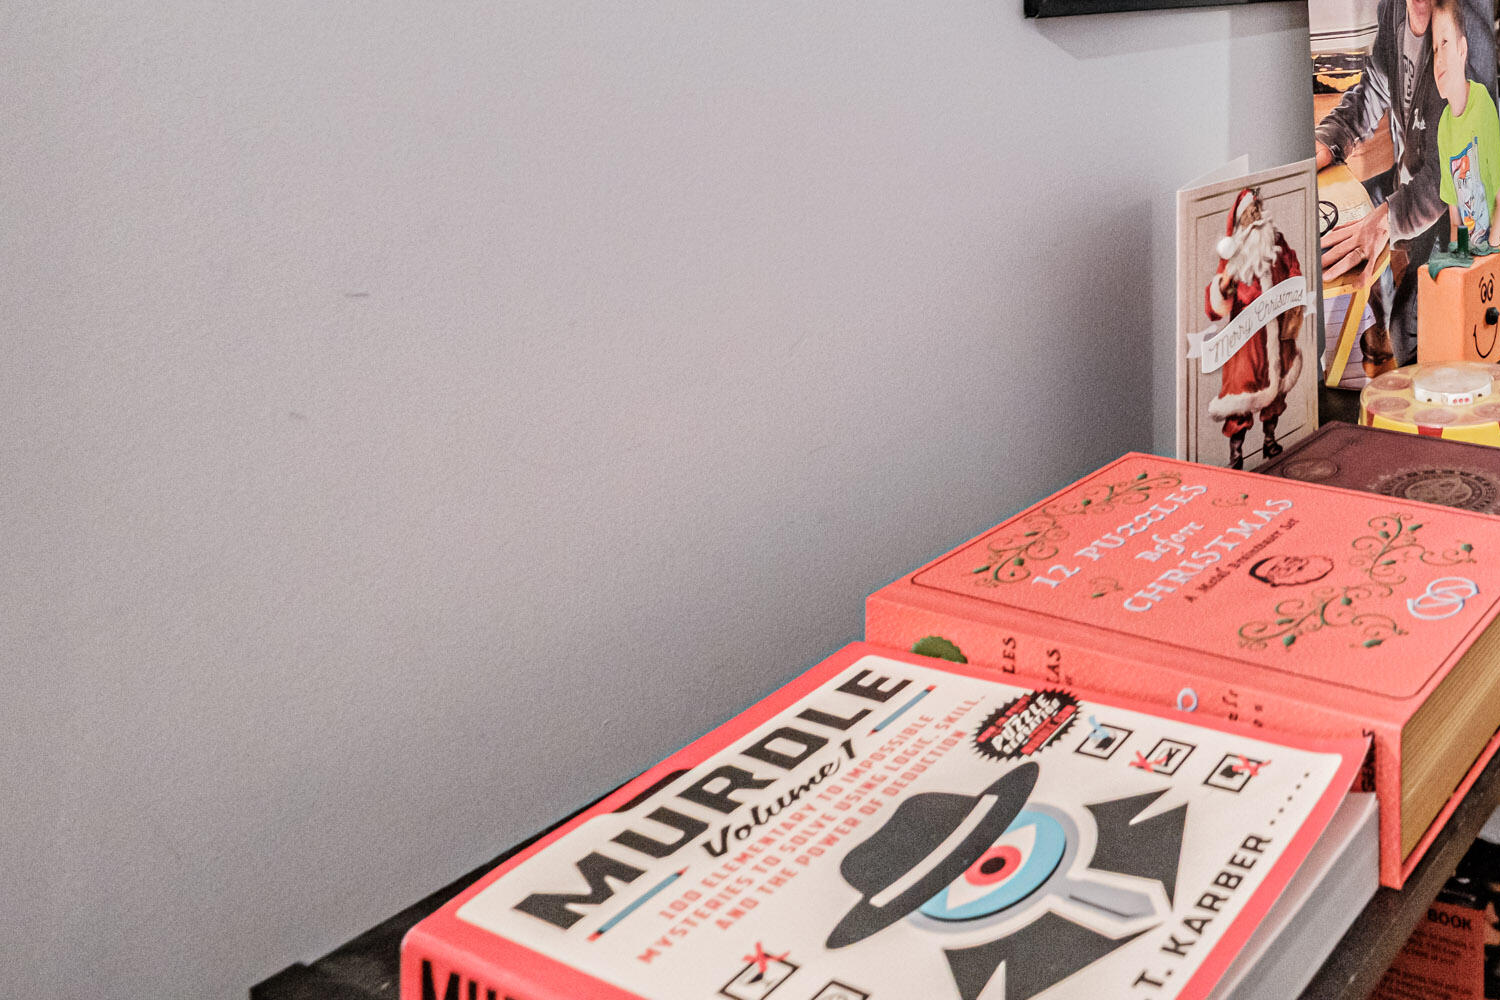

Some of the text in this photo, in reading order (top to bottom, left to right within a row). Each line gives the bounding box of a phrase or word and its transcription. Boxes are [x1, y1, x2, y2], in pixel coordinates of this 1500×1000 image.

[1209, 289, 1304, 363] Merry Christmas
[1032, 485, 1207, 588] 12 PUZZLES
[1124, 499, 1293, 612] CHRISTMAS
[991, 694, 1050, 752] PUZZLE
[512, 669, 914, 931] MURDLE
[659, 889, 702, 920] 100
[701, 803, 817, 888] ELEMENTARY
[818, 783, 843, 803] TO
[842, 714, 935, 785] IMPOSSIBLE
[701, 757, 842, 858] Volume
[715, 730, 969, 931] AND THE POWER OF DEDUCTION
[637, 876, 754, 964] MYSTERIES
[752, 854, 781, 877] TO
[780, 814, 837, 854] SOLVE
[840, 773, 888, 812] USING
[1132, 833, 1273, 990] T. KARBER
[1427, 908, 1472, 930] BOOK
